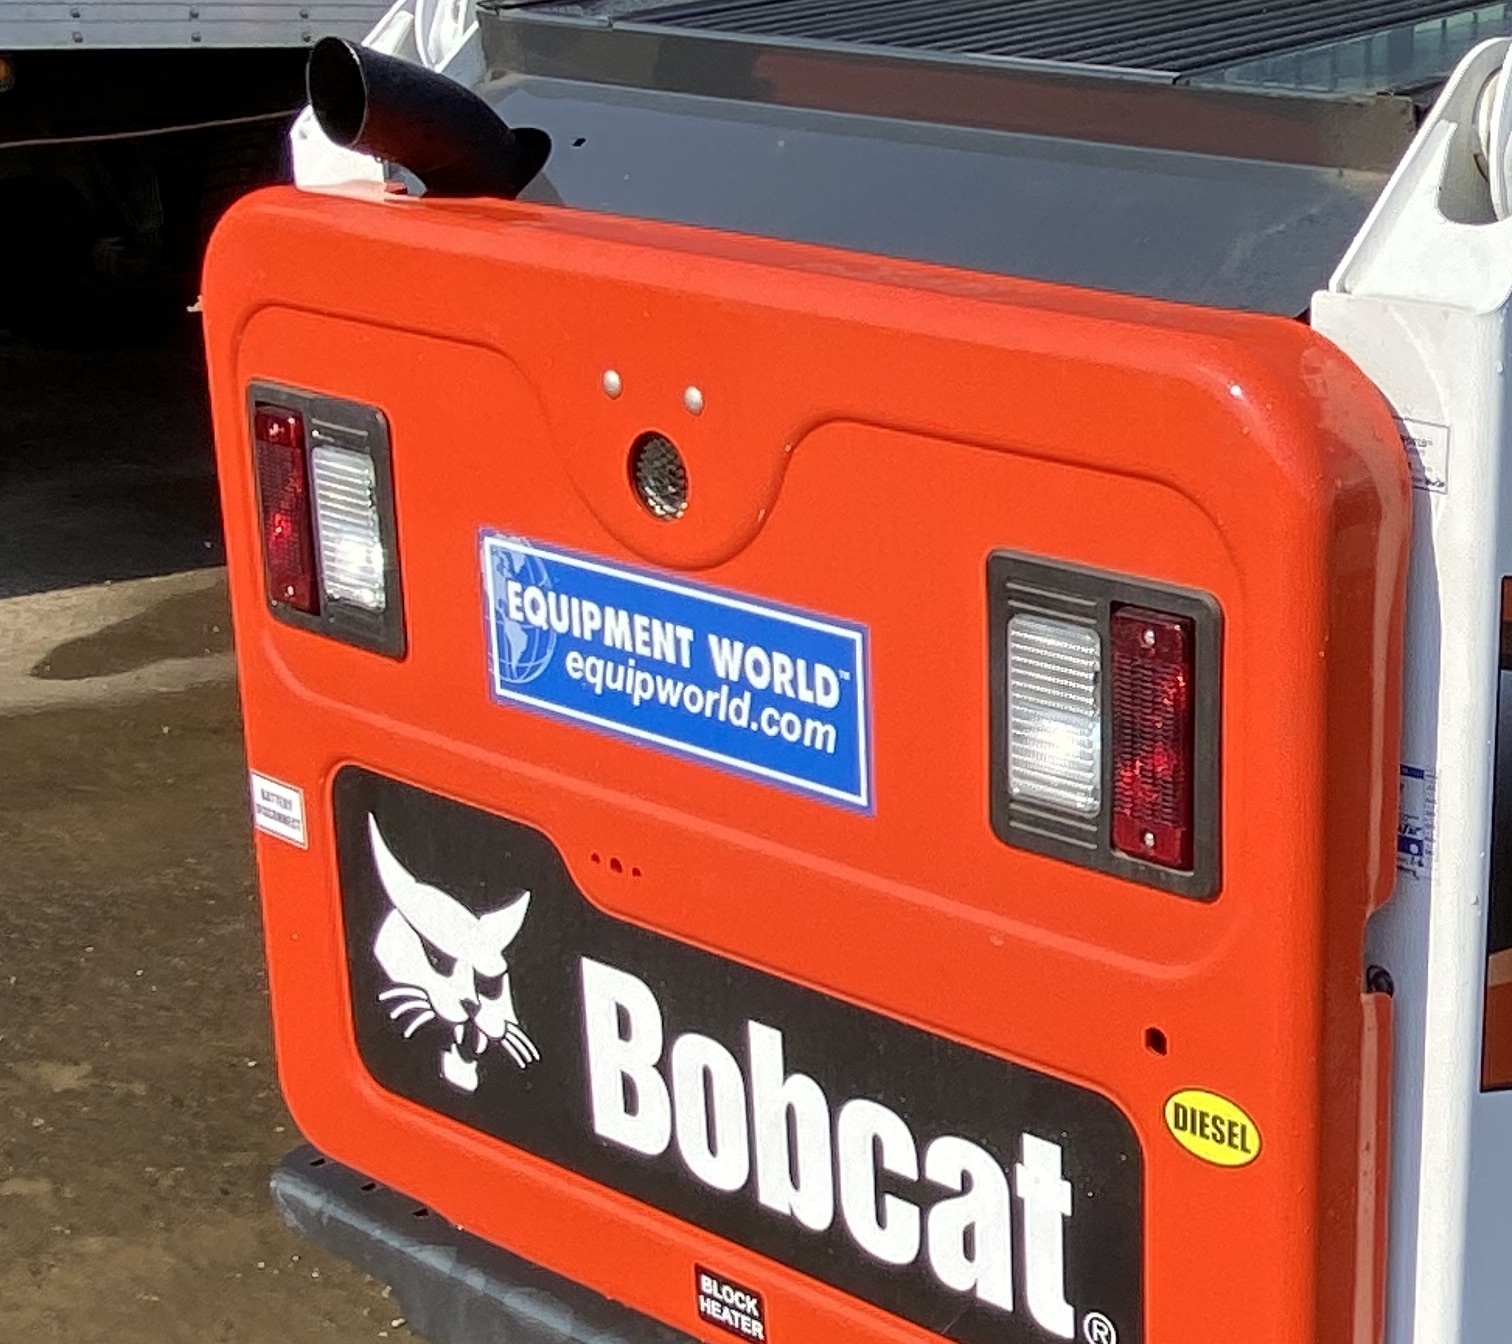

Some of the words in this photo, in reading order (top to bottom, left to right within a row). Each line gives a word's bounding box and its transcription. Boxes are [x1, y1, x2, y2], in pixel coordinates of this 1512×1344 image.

[506, 580, 694, 668] EQUIPMENT
[708, 633, 841, 709] WORLD
[565, 650, 837, 754] equipworld.com
[581, 955, 1075, 1340] Bobcat
[1172, 1101, 1252, 1155] DIESEL
[698, 1294, 765, 1341] HEATER
[700, 1273, 760, 1317] BLOCK
